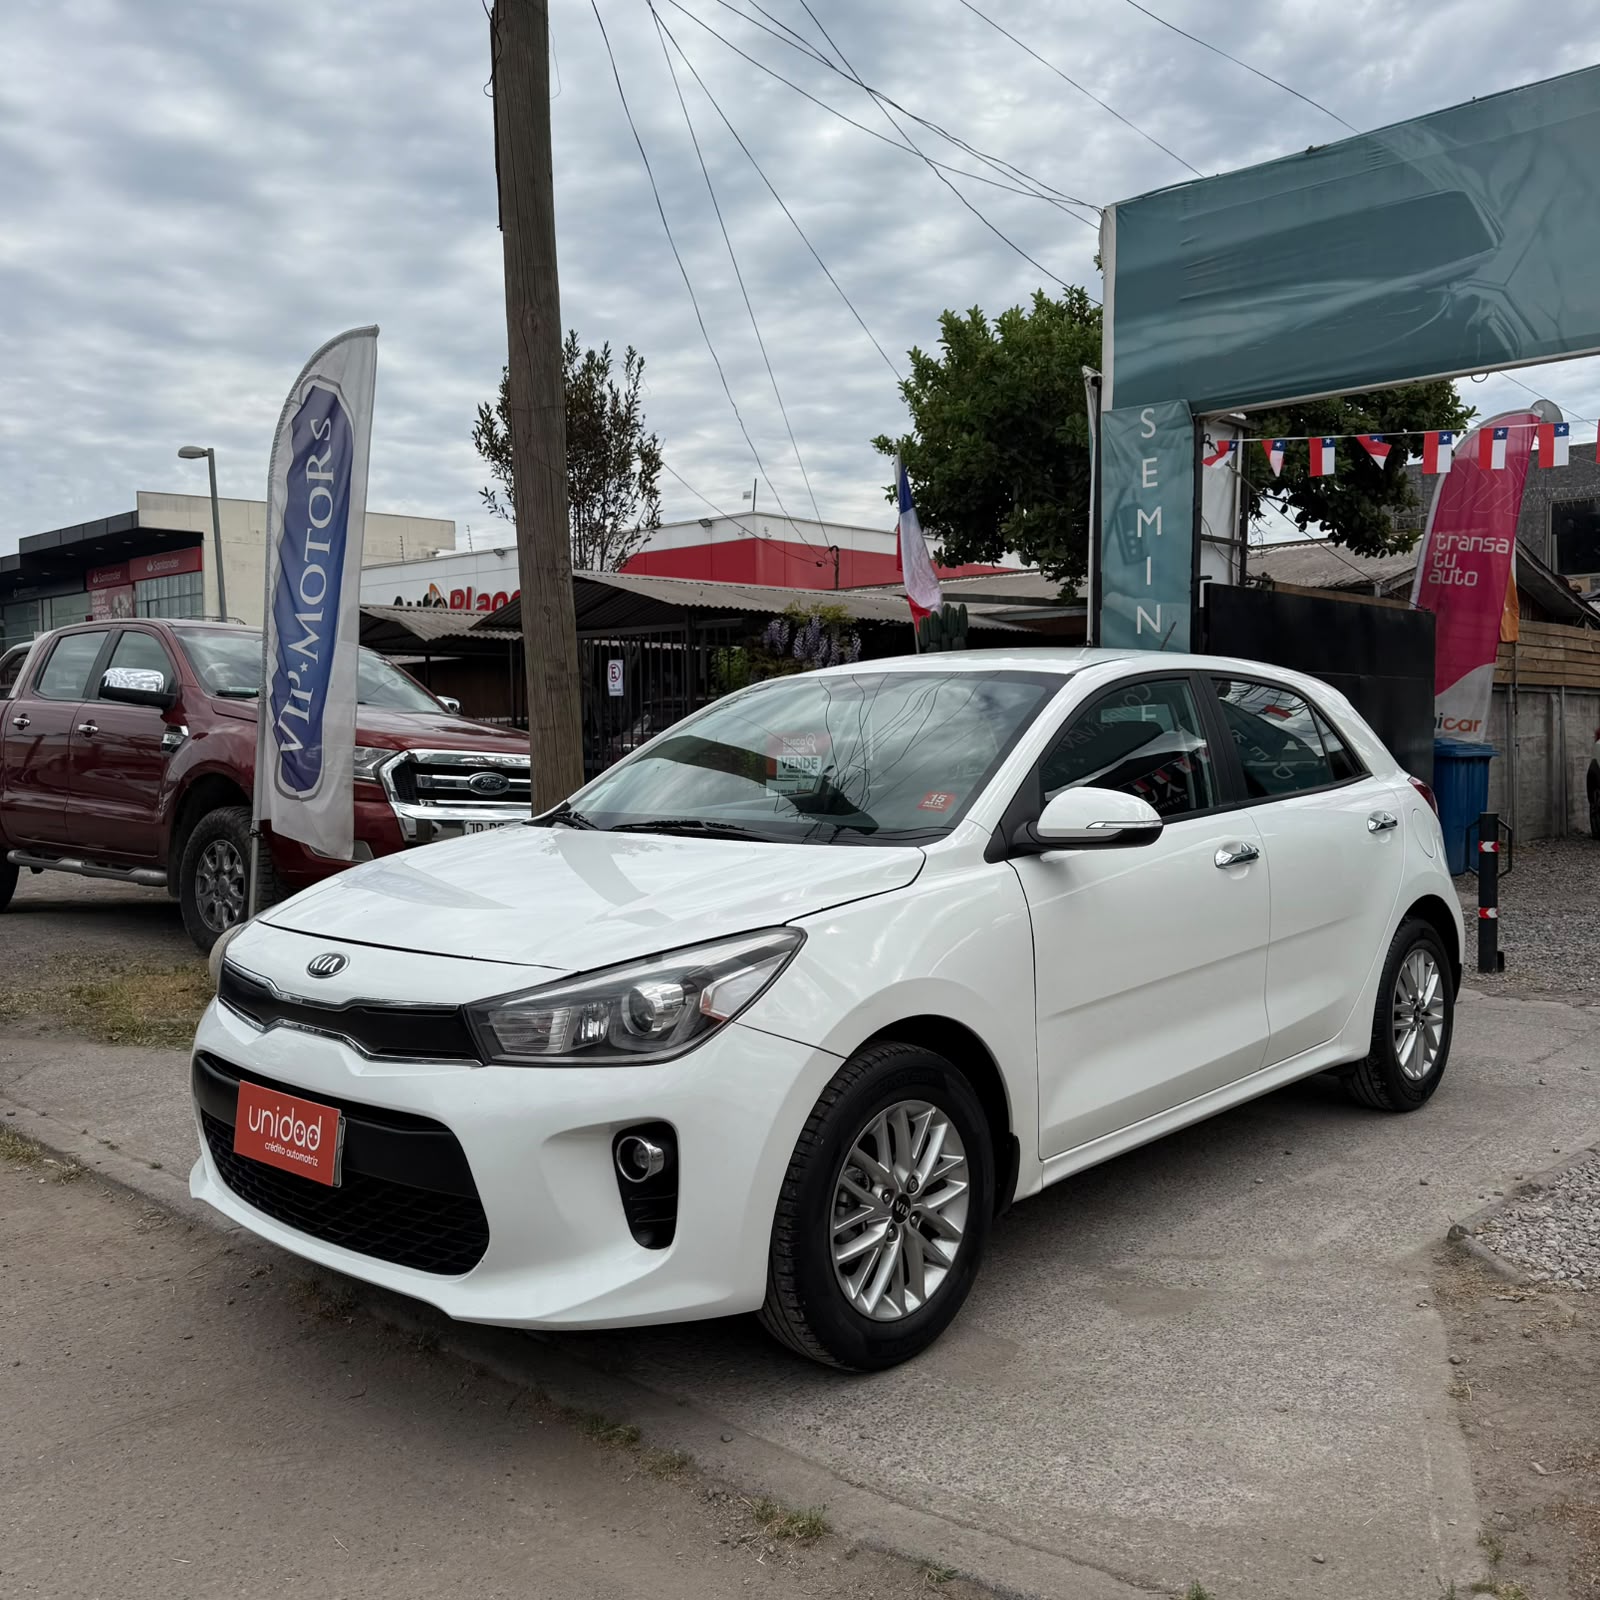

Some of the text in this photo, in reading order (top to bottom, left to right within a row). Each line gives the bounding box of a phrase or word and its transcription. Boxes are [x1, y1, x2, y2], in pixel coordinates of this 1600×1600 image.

[1435, 532, 1511, 555] transa
[1433, 552, 1456, 569] tu
[277, 416, 335, 753] VIP MOTORS
[1428, 568, 1478, 587] auto
[1434, 712, 1482, 732] icar
[780, 757, 818, 769] VENDE
[480, 777, 503, 789] Ford
[931, 794, 948, 803] 15
[309, 954, 341, 973] KIA
[248, 1105, 322, 1151] unidad
[264, 1141, 319, 1167] crédito automotriz
